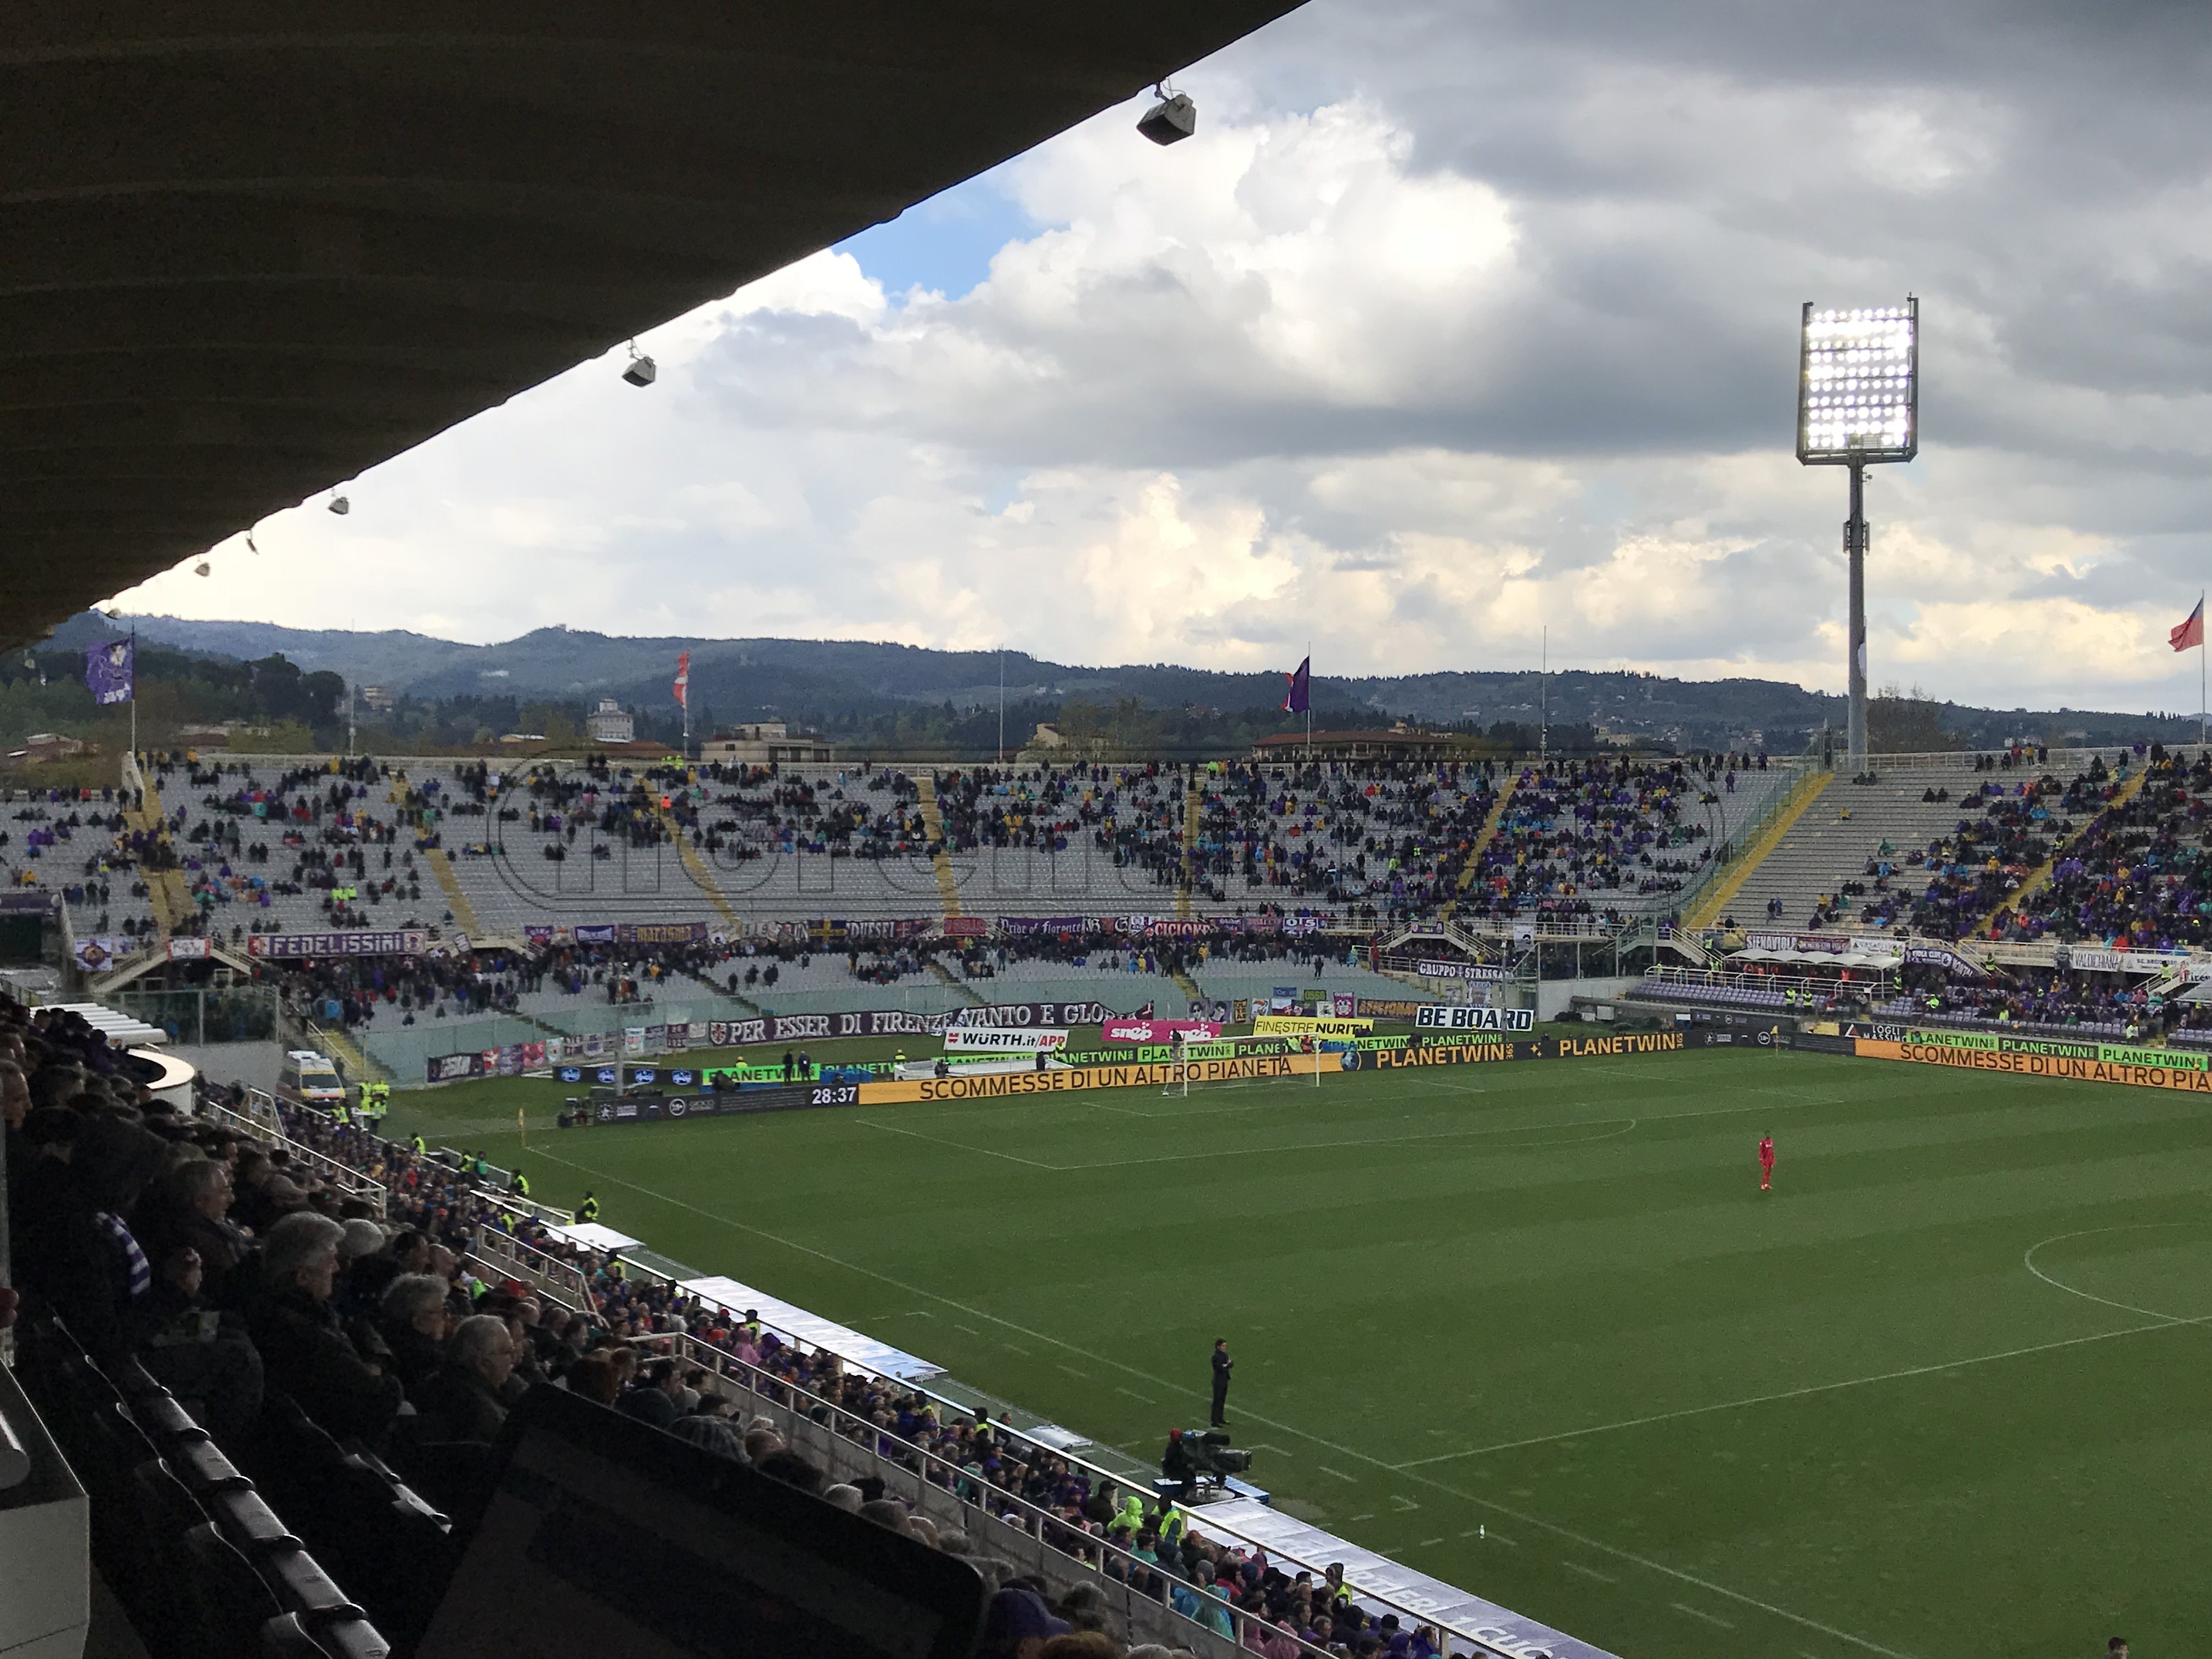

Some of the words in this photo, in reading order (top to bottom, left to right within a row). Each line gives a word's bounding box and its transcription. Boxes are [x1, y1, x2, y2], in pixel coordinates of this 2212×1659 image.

[1001, 917, 1026, 934] Pride
[1030, 919, 1037, 933] of
[1419, 963, 1455, 977] GRUPPO
[966, 1005, 1031, 1028] VANTO
[1040, 1004, 1055, 1024] E
[1358, 1000, 1434, 1016] AFICIONAD
[729, 1019, 766, 1043] PER
[774, 1015, 831, 1039] ESSER
[840, 1013, 861, 1034] DI
[871, 1012, 953, 1034] FIRENZE
[1256, 1020, 1314, 1033] FINESTRE
[1417, 1007, 1447, 1026] BE
[1451, 1008, 1532, 1030] BOARD
[1872, 1025, 1900, 1035] LOGLI
[1422, 1034, 1497, 1047] PLANETWIN
[1560, 1034, 1675, 1057] PLANETWIN
[1911, 1032, 1989, 1048] ANETWIN
[2002, 1040, 2089, 1058] PLANETWIN
[1376, 1043, 1505, 1069] PLANETWIN
[1900, 1043, 2024, 1071] SCOMMESSE
[2030, 1056, 2049, 1074] DI
[2057, 1059, 2086, 1078] UN
[2094, 1062, 2165, 1086] ALTRO
[2103, 1048, 2196, 1068] PLANETWIN
[919, 1071, 1064, 1100] SCOMMESSE
[1071, 1070, 1091, 1088] DI
[1098, 1068, 1127, 1086] UN
[1134, 1063, 1201, 1085] ALTRO
[1209, 1057, 1292, 1080] PIANETA
[812, 1086, 856, 1105] 28:37
